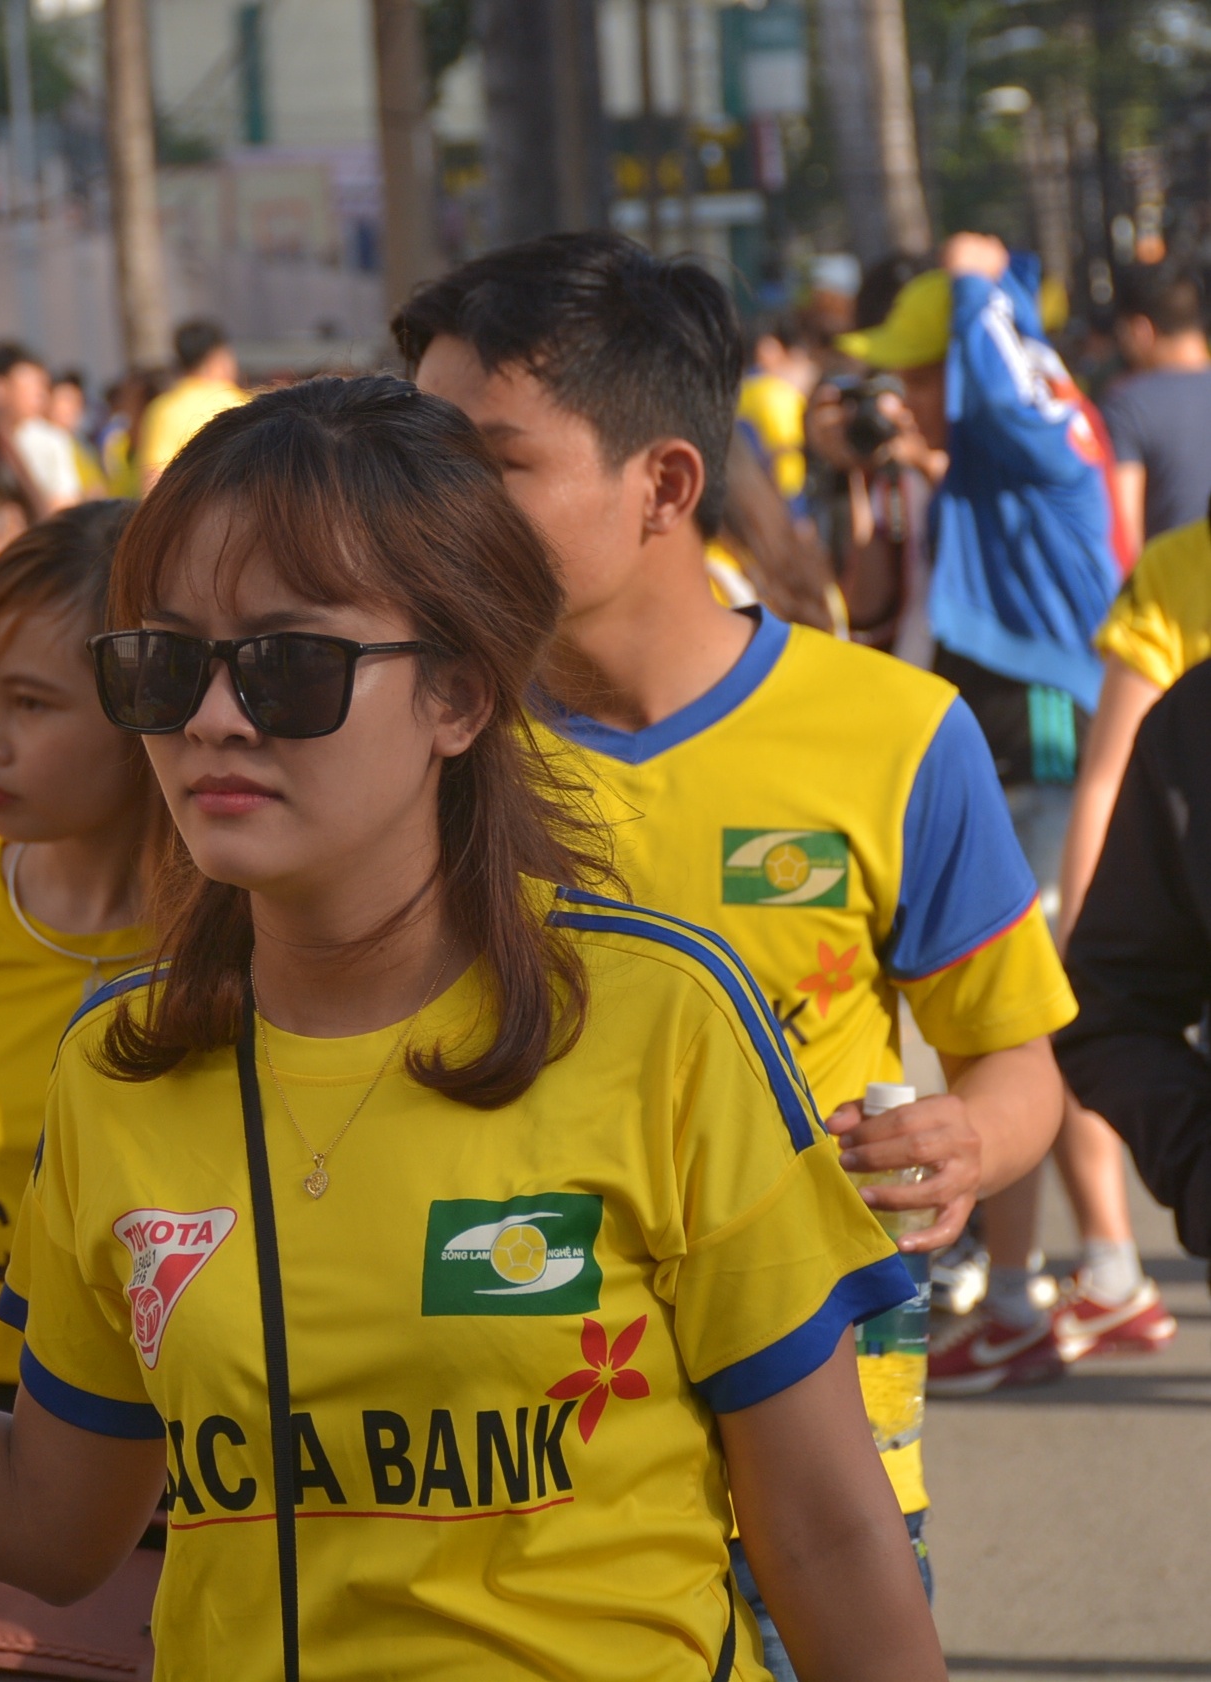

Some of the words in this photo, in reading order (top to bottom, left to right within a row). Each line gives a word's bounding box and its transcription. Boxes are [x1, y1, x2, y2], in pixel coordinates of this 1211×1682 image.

[123, 1219, 214, 1252] TOYOTA
[441, 1250, 468, 1261] SÔNG
[469, 1251, 490, 1261] LAM
[547, 1246, 572, 1259] NGHỆ
[572, 1248, 584, 1257] AN
[167, 1414, 257, 1516] AC
[361, 1399, 580, 1509] BANK
